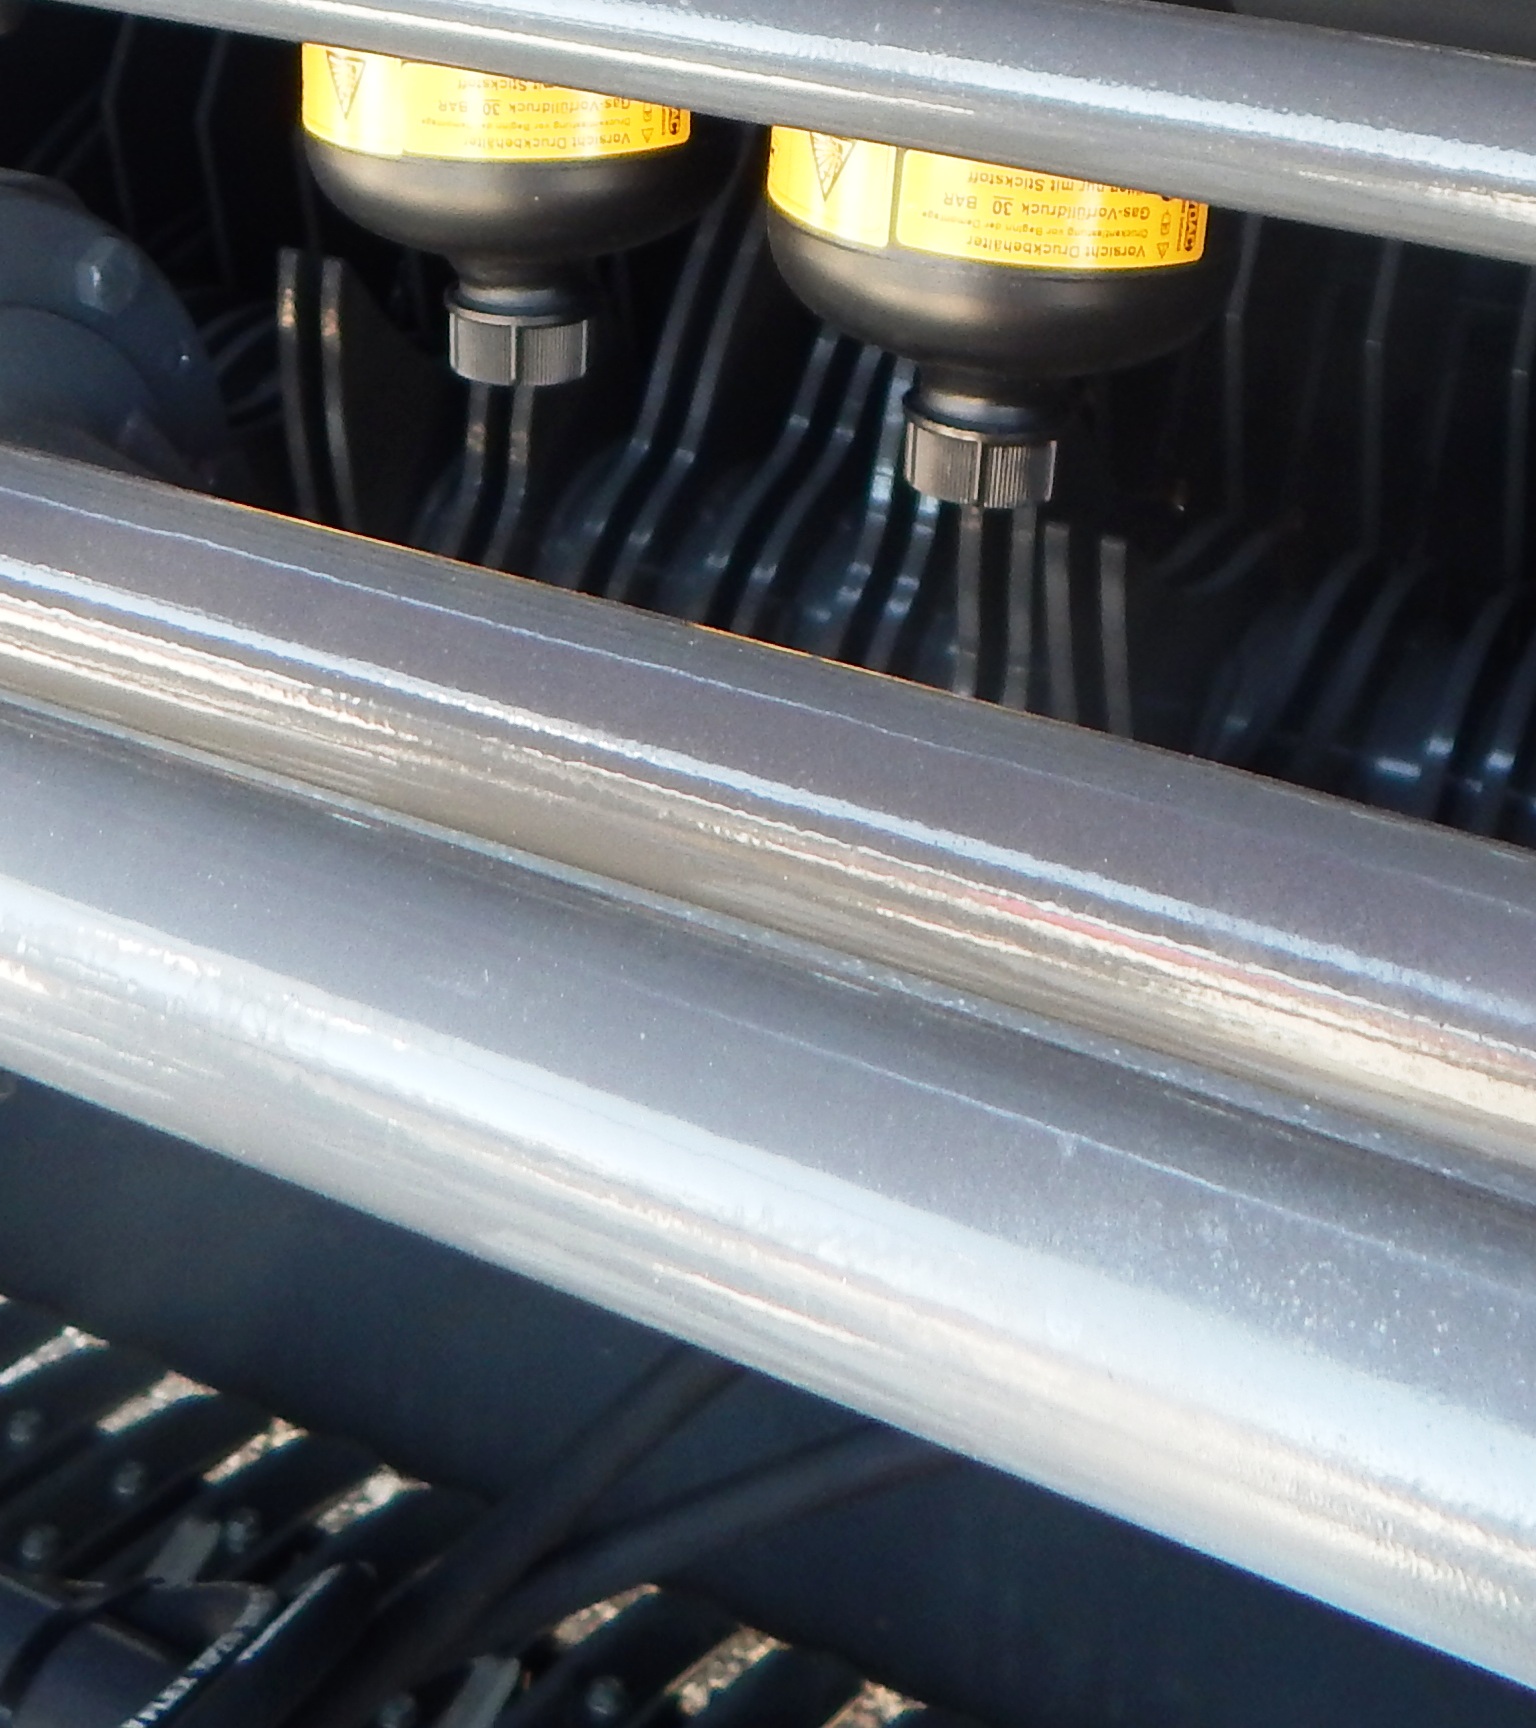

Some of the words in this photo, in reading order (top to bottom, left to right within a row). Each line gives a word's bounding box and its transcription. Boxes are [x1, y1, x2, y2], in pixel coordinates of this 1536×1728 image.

[482, 99, 501, 116] 30
[966, 171, 1045, 192] Stickstoff
[1050, 180, 1075, 194] mit
[942, 192, 978, 210] BAR
[992, 196, 1015, 216] 30
[1020, 201, 1151, 221] Gas-Vorfülldruck
[965, 234, 1080, 259] Druckbehälter
[1085, 243, 1147, 259] Vorsicht
